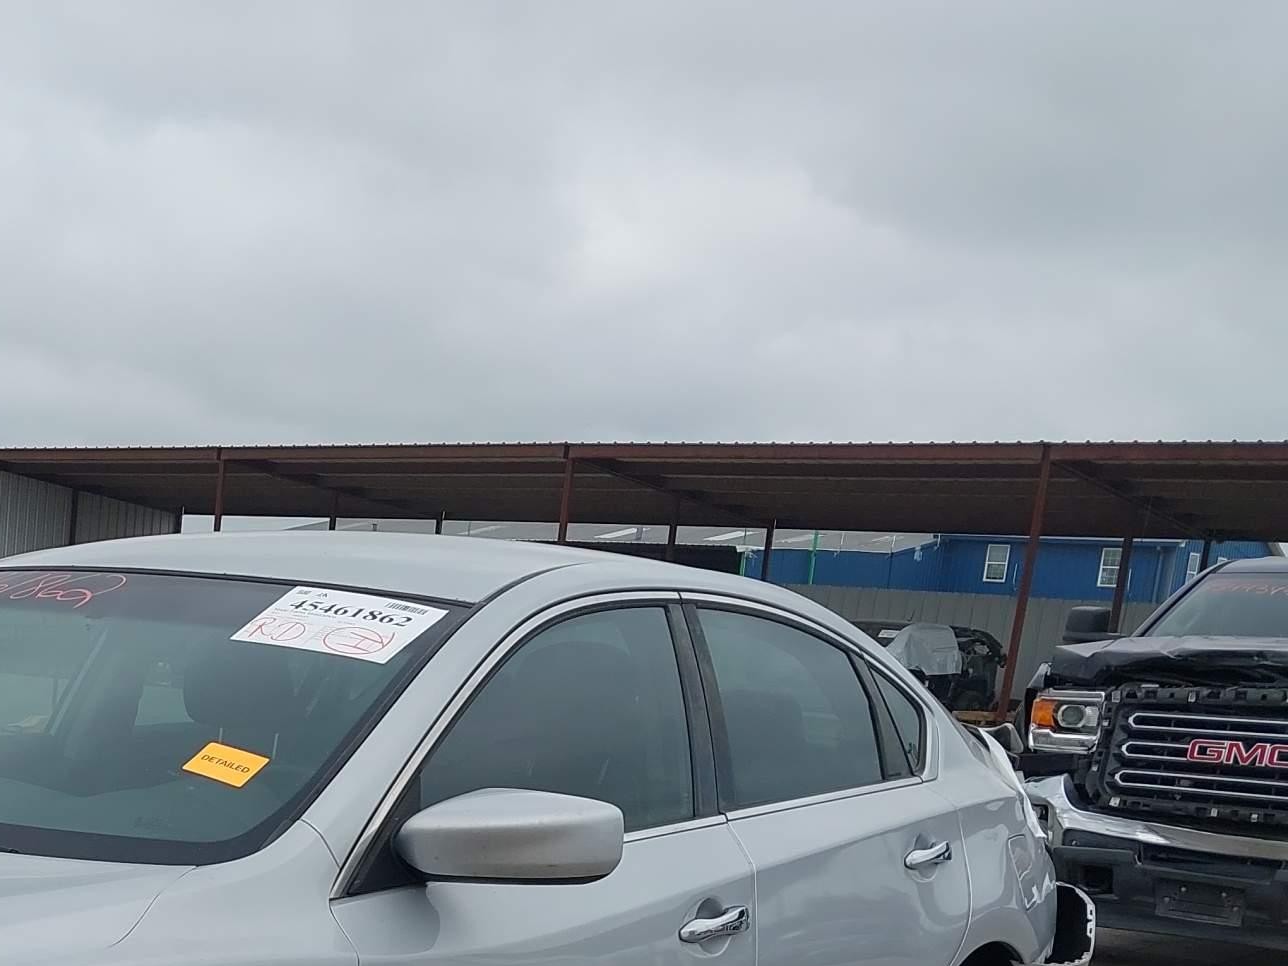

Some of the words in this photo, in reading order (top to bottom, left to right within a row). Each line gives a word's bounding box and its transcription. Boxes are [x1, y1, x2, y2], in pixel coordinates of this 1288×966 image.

[290, 599, 413, 627] 45461862
[200, 754, 251, 775] DETAILED
[1187, 739, 1288, 768] GMC
